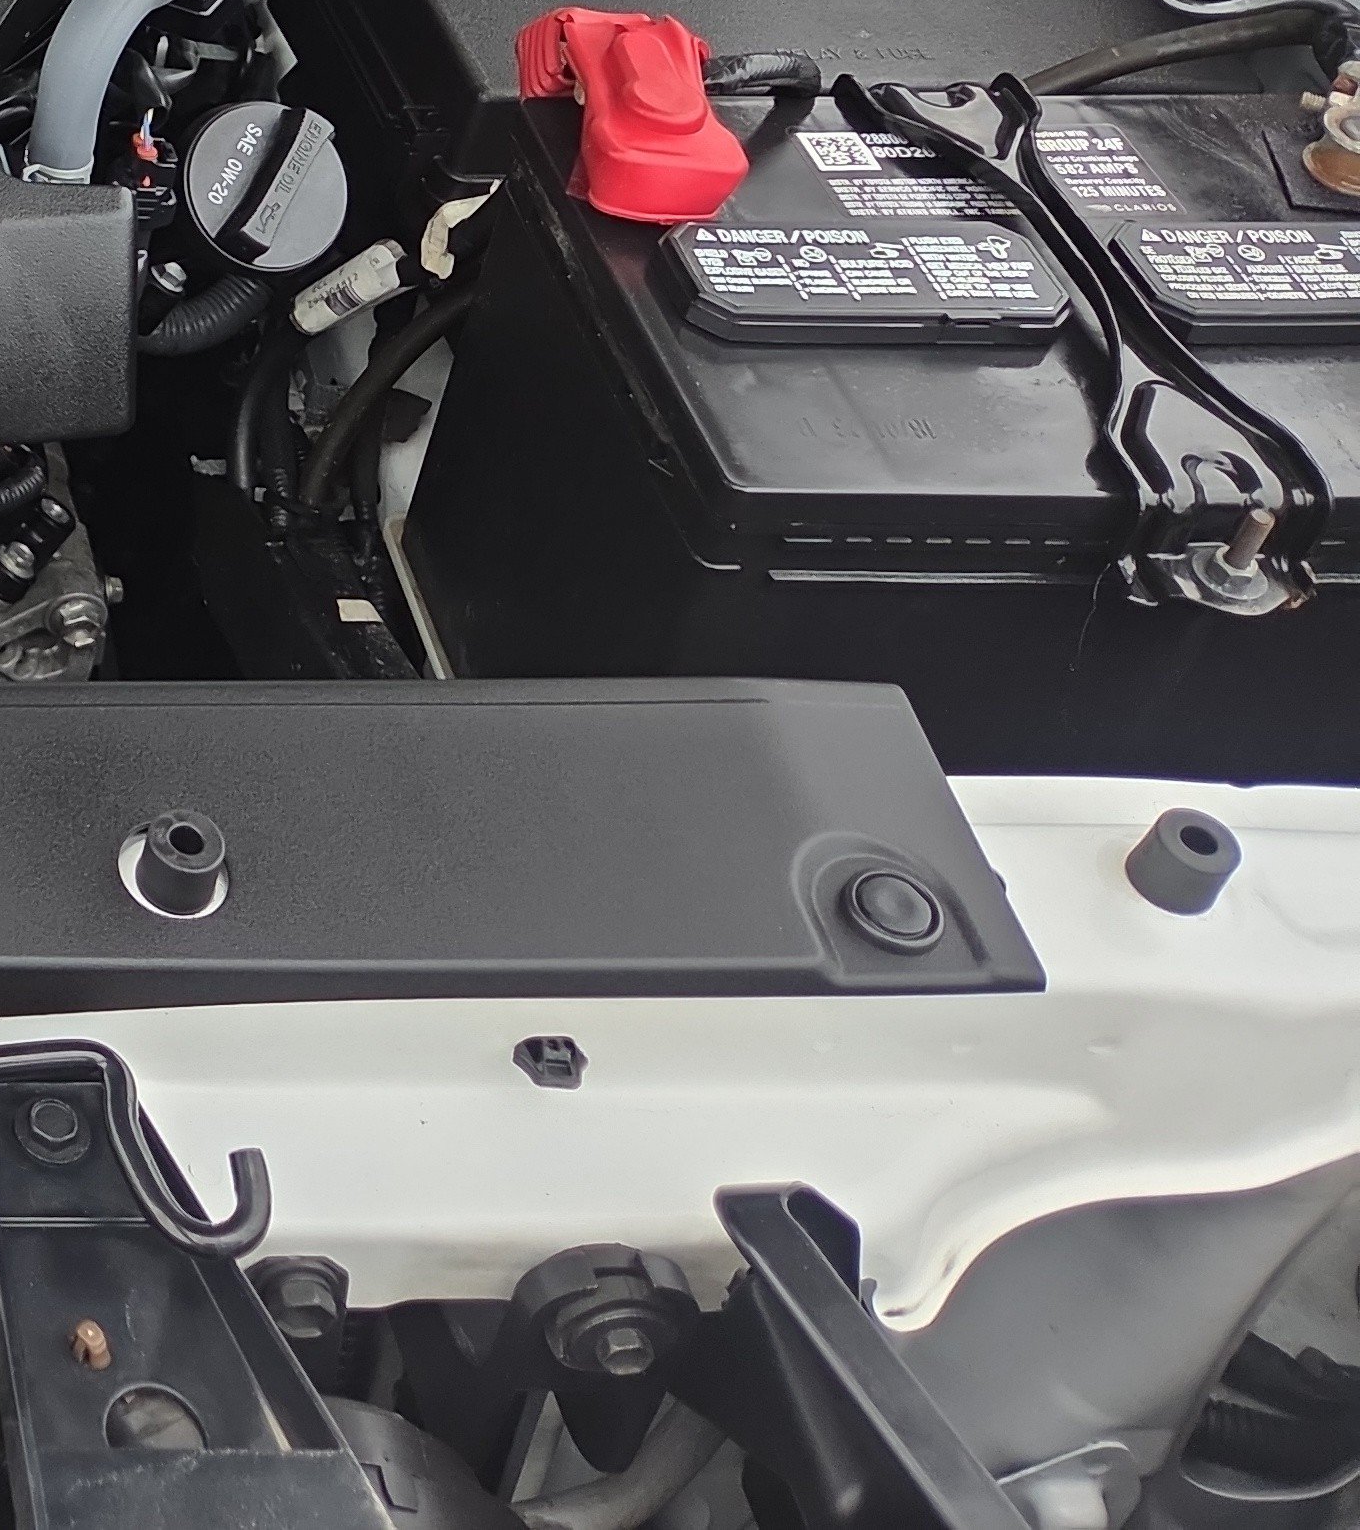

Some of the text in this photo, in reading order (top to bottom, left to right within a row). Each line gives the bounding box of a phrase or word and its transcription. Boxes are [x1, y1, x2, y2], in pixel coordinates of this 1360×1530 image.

[1035, 137, 1124, 152] GROUP 24F
[207, 122, 263, 205] SAE 0W-20
[274, 119, 322, 195] ENGINE OIL
[1046, 155, 1071, 163] Cold
[1111, 154, 1140, 164] Amps
[1052, 162, 1139, 175] 582 AMPS
[1064, 177, 1146, 186] Reserve Capacity
[1071, 185, 1167, 198] 125 MINUTES
[1113, 203, 1177, 213] CLARIOS
[715, 228, 788, 244] DANGER
[800, 229, 870, 244] POISON
[1160, 229, 1234, 244] DANGER
[1245, 229, 1316, 244] POISON
